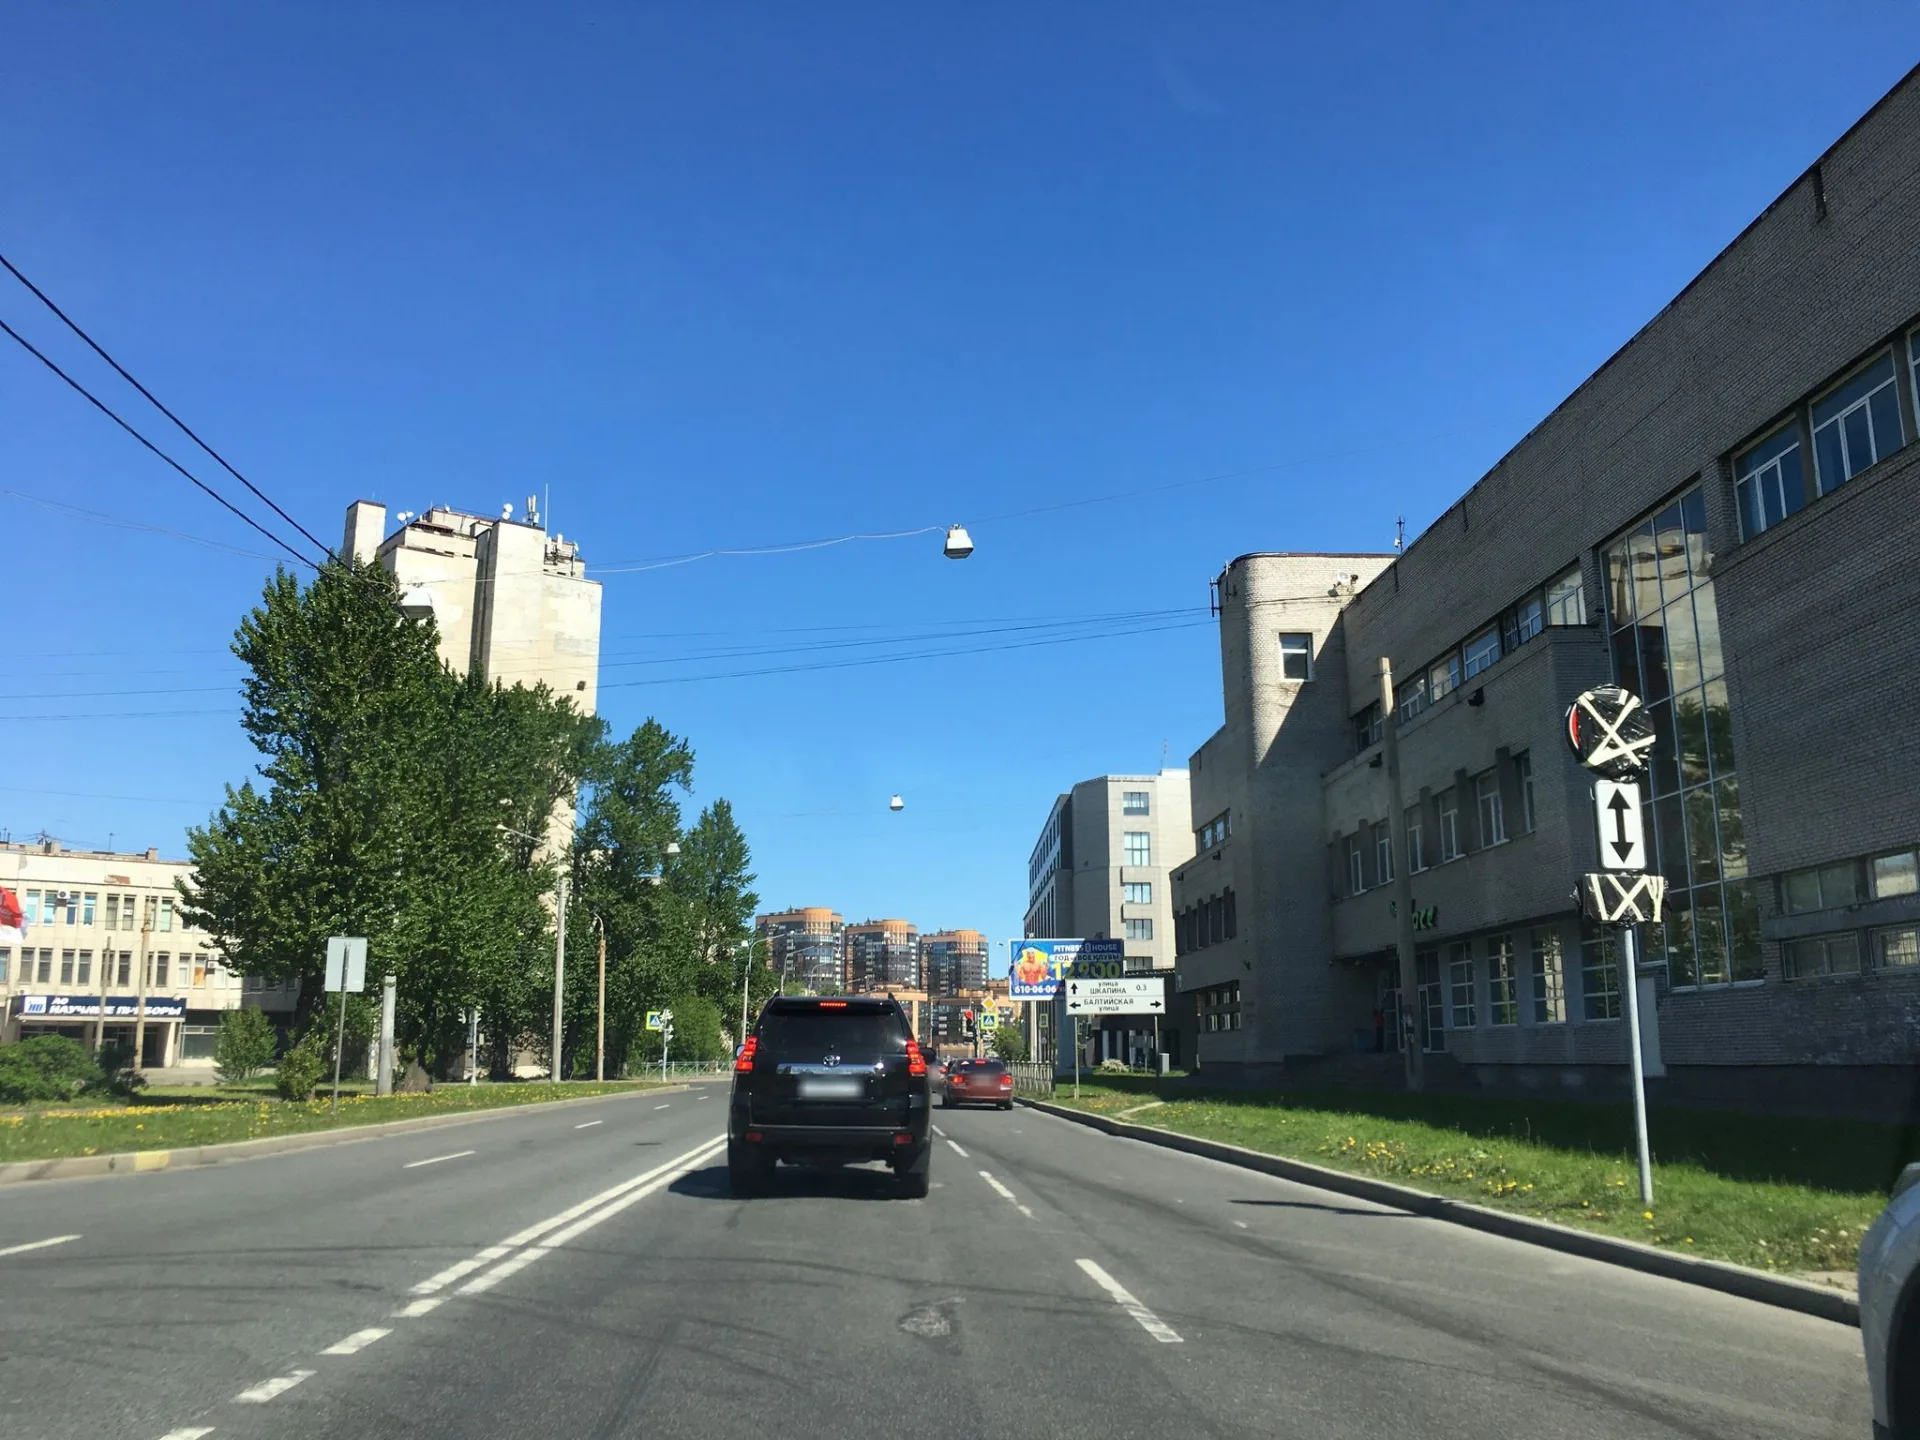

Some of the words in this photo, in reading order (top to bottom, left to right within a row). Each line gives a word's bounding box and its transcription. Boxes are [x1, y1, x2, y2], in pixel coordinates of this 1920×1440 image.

[1053, 944, 1085, 953] FITNESS
[1092, 943, 1117, 951] HOUSE
[1014, 985, 1057, 994] 610-06-06
[1089, 987, 1127, 995] ШКАПИНА
[51, 997, 69, 1005] АО
[1084, 997, 1134, 1005] БАЛТИЙСКАЯ
